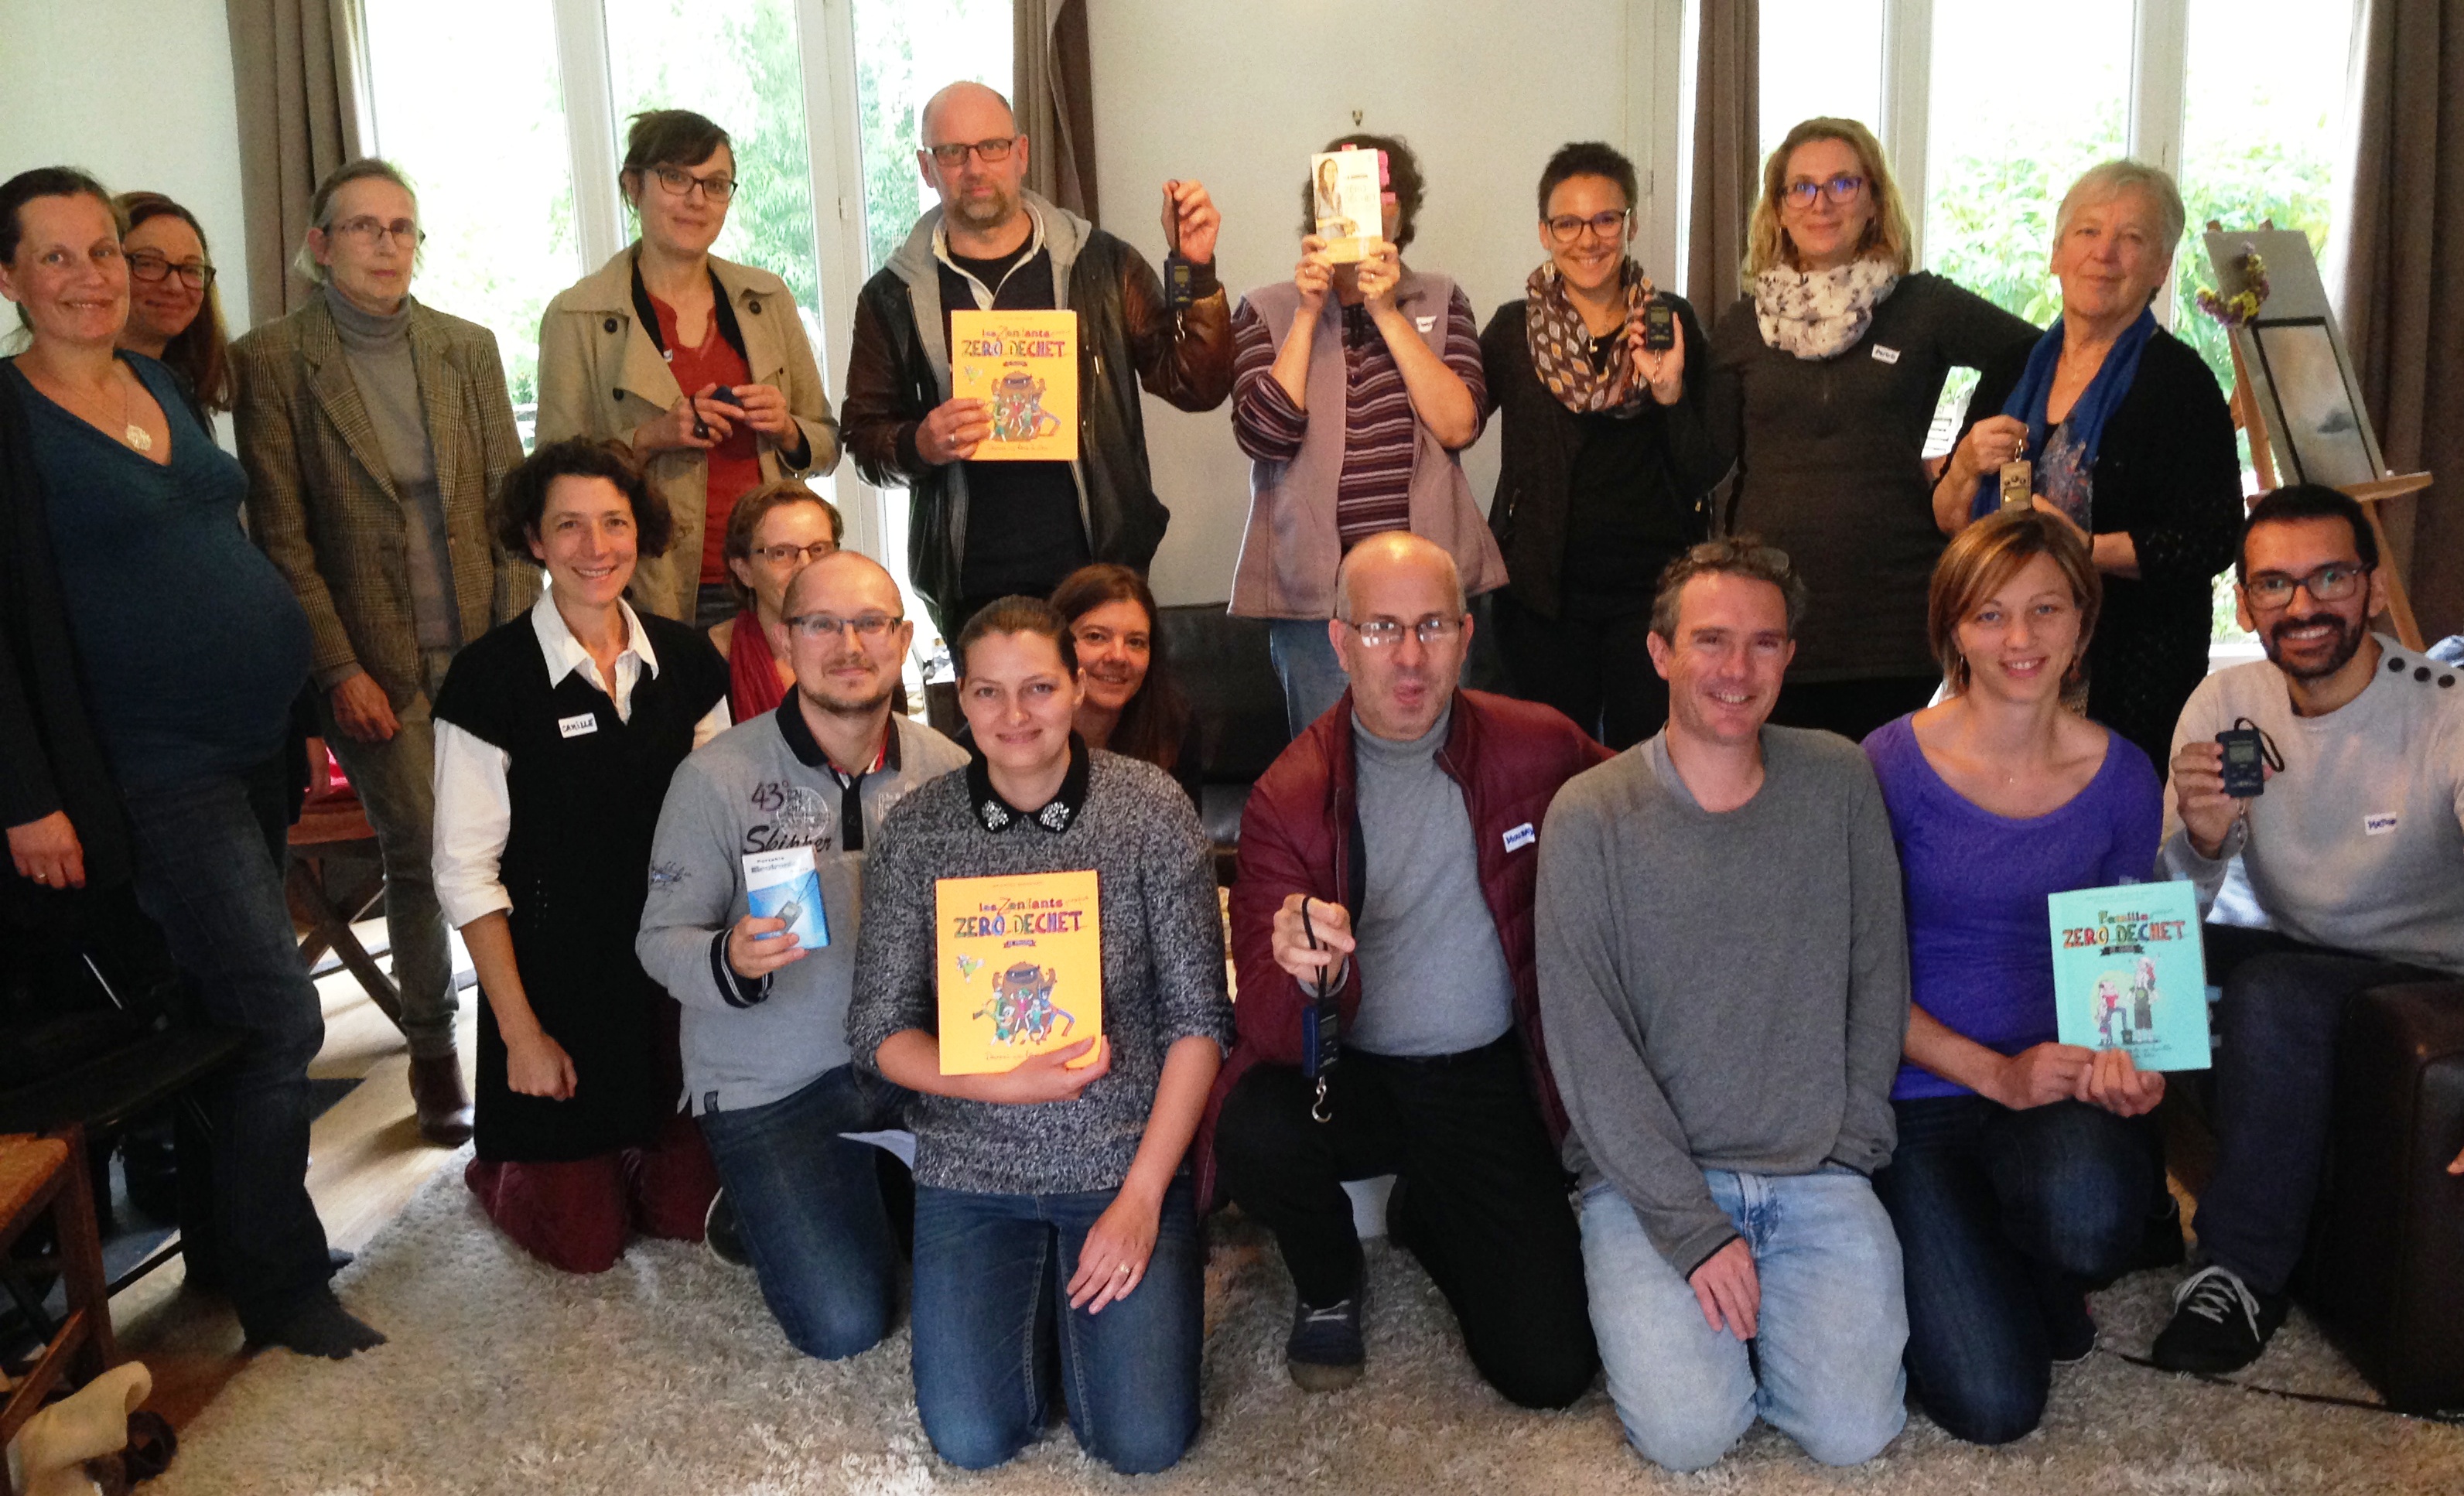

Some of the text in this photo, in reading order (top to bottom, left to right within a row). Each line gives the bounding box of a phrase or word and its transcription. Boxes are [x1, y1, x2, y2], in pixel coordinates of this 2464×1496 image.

[962, 340, 1065, 357] ZERO DECHET
[953, 910, 1083, 938] ZERO DECHET
[2062, 920, 2185, 949] ZERO DECHET
